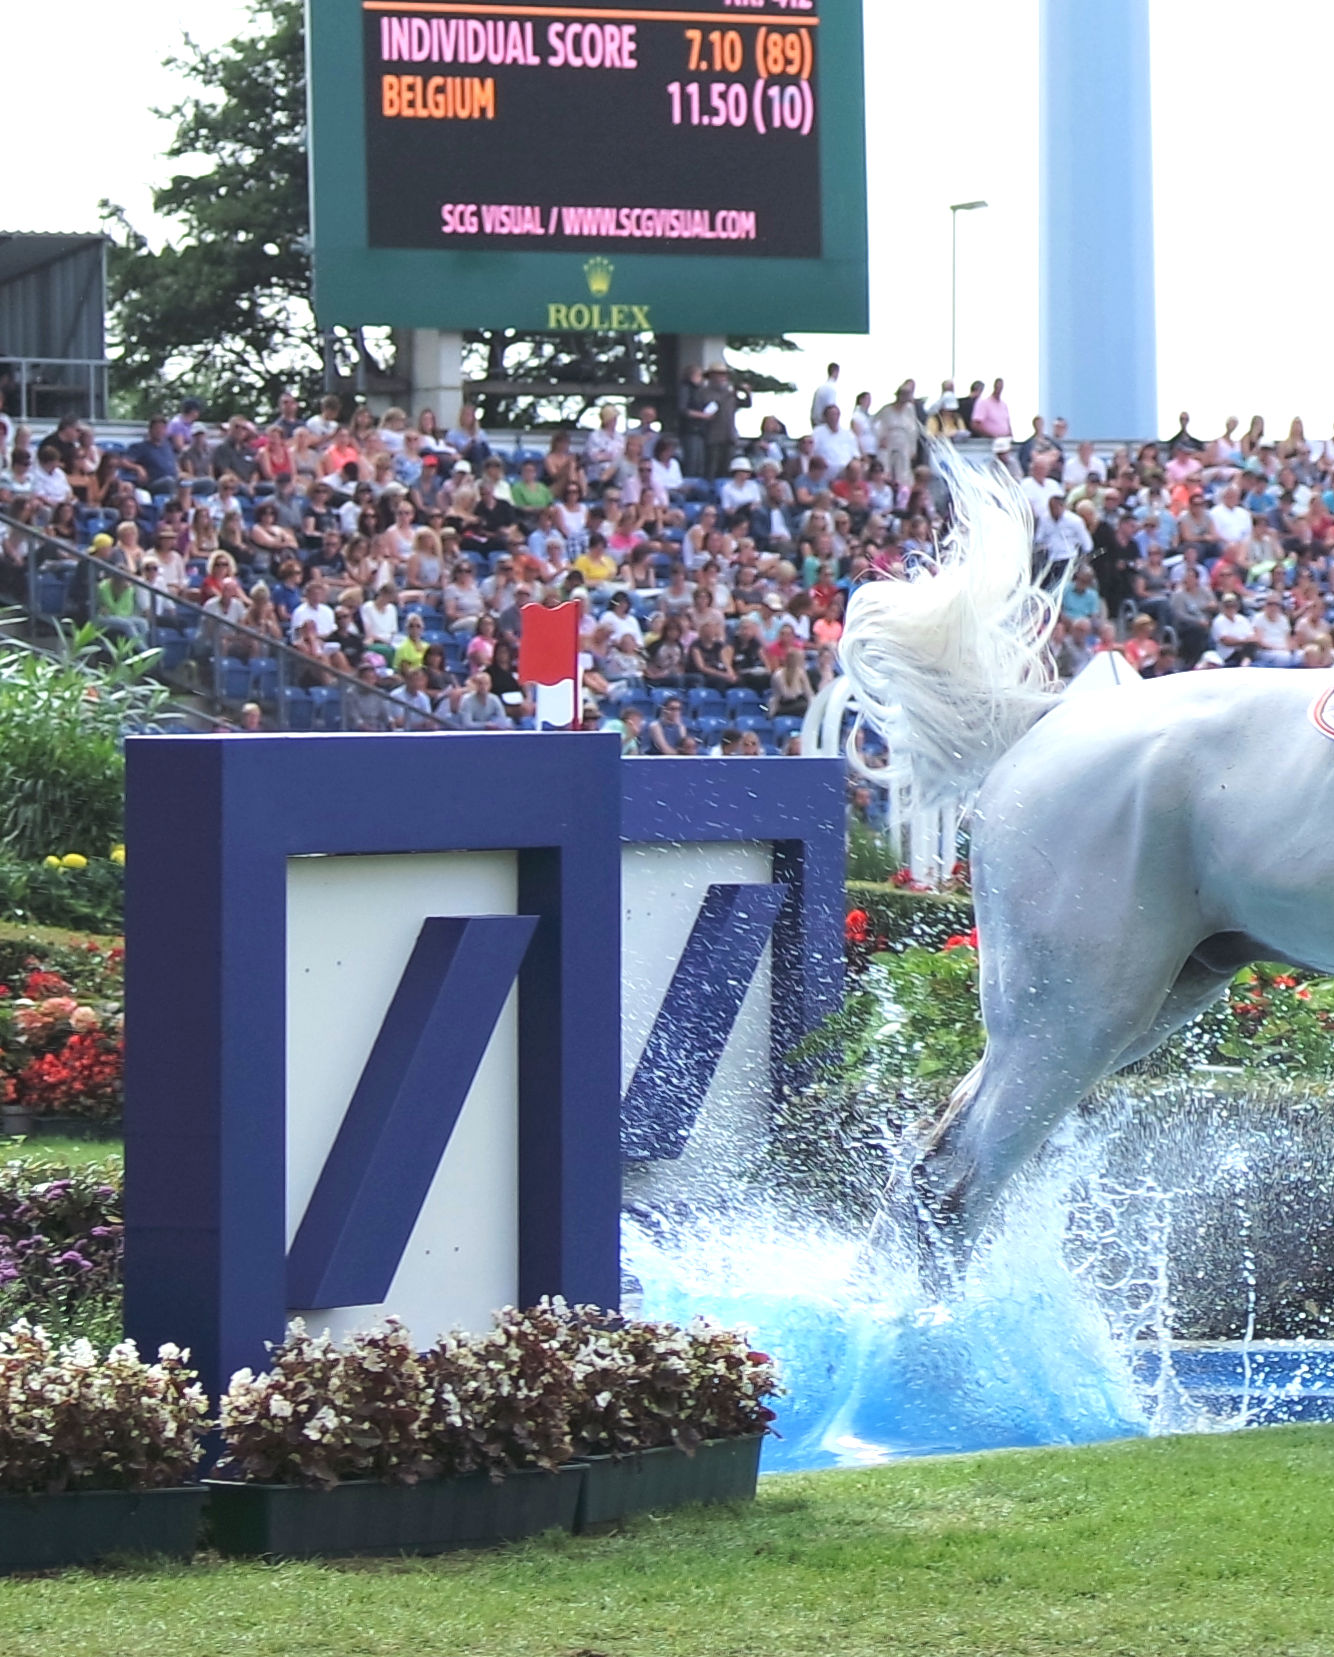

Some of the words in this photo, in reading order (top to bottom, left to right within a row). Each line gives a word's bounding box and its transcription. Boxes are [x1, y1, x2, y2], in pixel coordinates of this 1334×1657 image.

[381, 16, 541, 66] INDIVIDUAL
[547, 22, 637, 69] SCORE
[684, 28, 743, 72] 7.10
[756, 26, 812, 79] (89)
[382, 75, 495, 119] BELGIUM
[667, 81, 748, 127] 11.50
[753, 78, 814, 135] (10)
[441, 204, 478, 234] SCG
[481, 205, 545, 235] VISUAL
[561, 207, 756, 240] WWW.SCGVISUAL.COM
[548, 304, 651, 331] ROLEX
